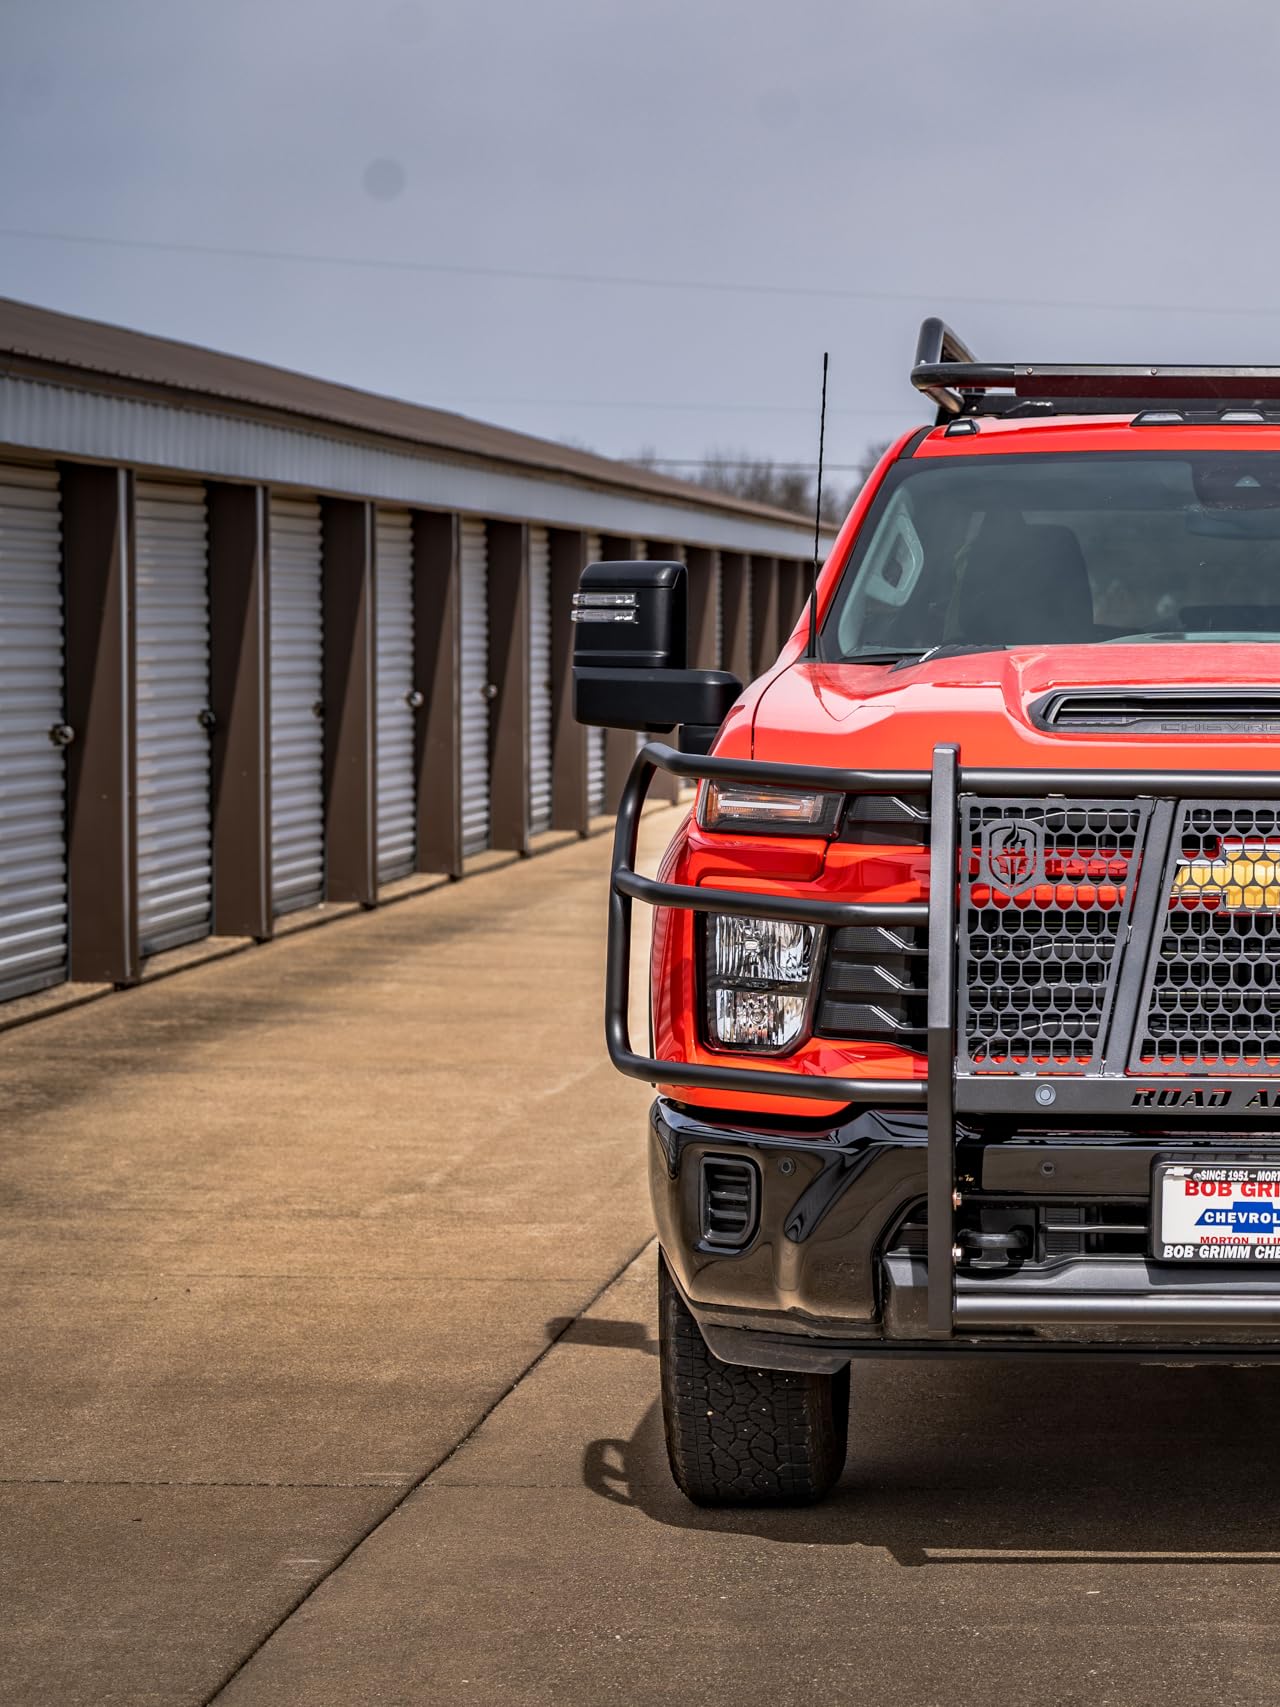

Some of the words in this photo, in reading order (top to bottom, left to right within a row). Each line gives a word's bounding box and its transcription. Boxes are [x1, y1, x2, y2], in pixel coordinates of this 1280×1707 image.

[1130, 1087, 1232, 1108] ROAD
[1201, 1169, 1227, 1181] SINCE
[1185, 1180, 1232, 1197] BOB
[1200, 1236, 1249, 1245] MORTON
[1163, 1244, 1195, 1258] BOB
[1198, 1244, 1252, 1259] GRIMM
